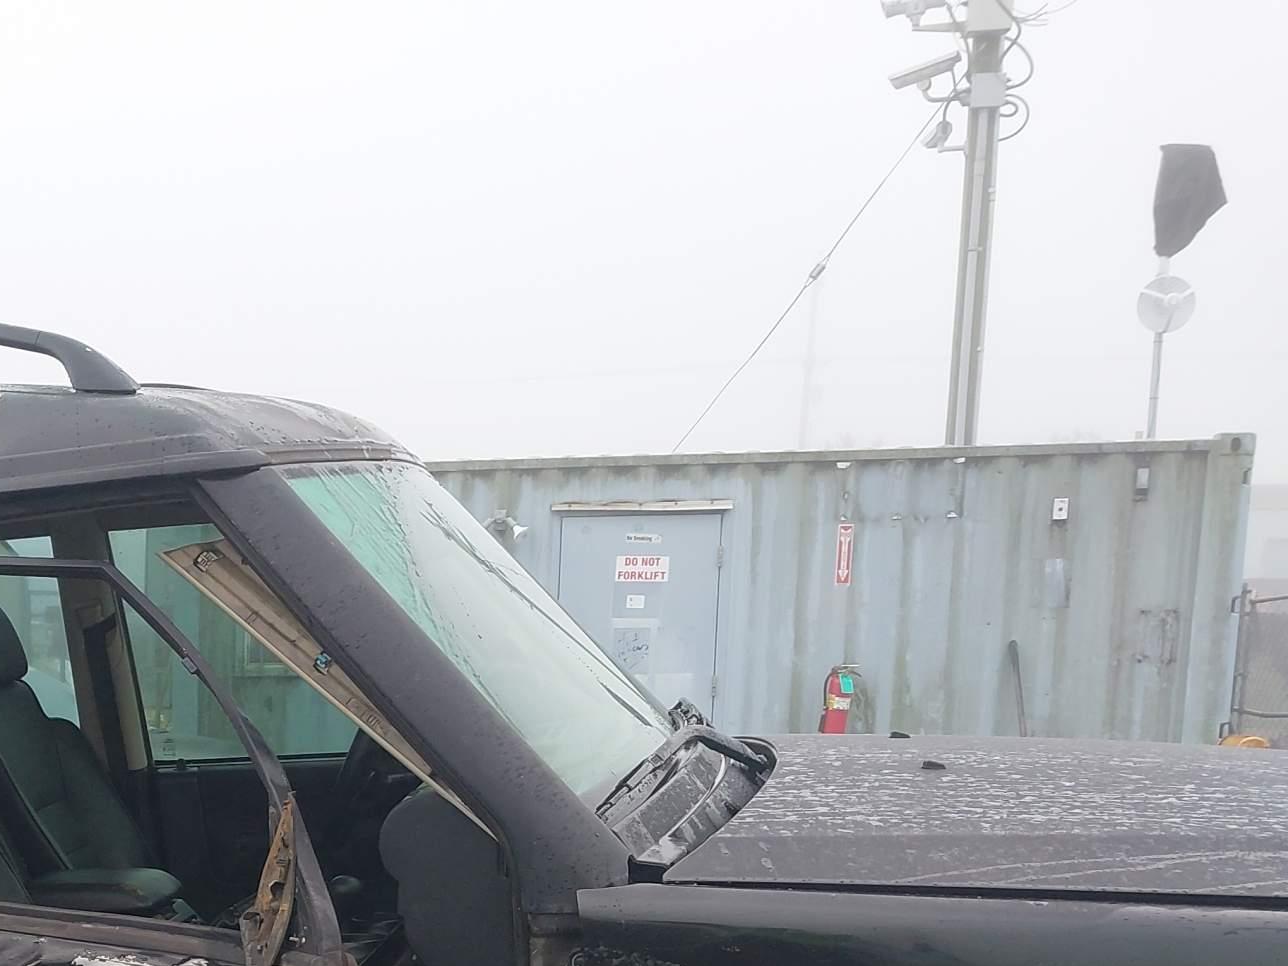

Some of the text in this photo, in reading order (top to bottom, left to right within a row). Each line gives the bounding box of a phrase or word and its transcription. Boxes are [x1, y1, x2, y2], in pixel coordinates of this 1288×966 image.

[624, 557, 661, 566] DO NOT
[617, 571, 666, 580] FORKLIFT
